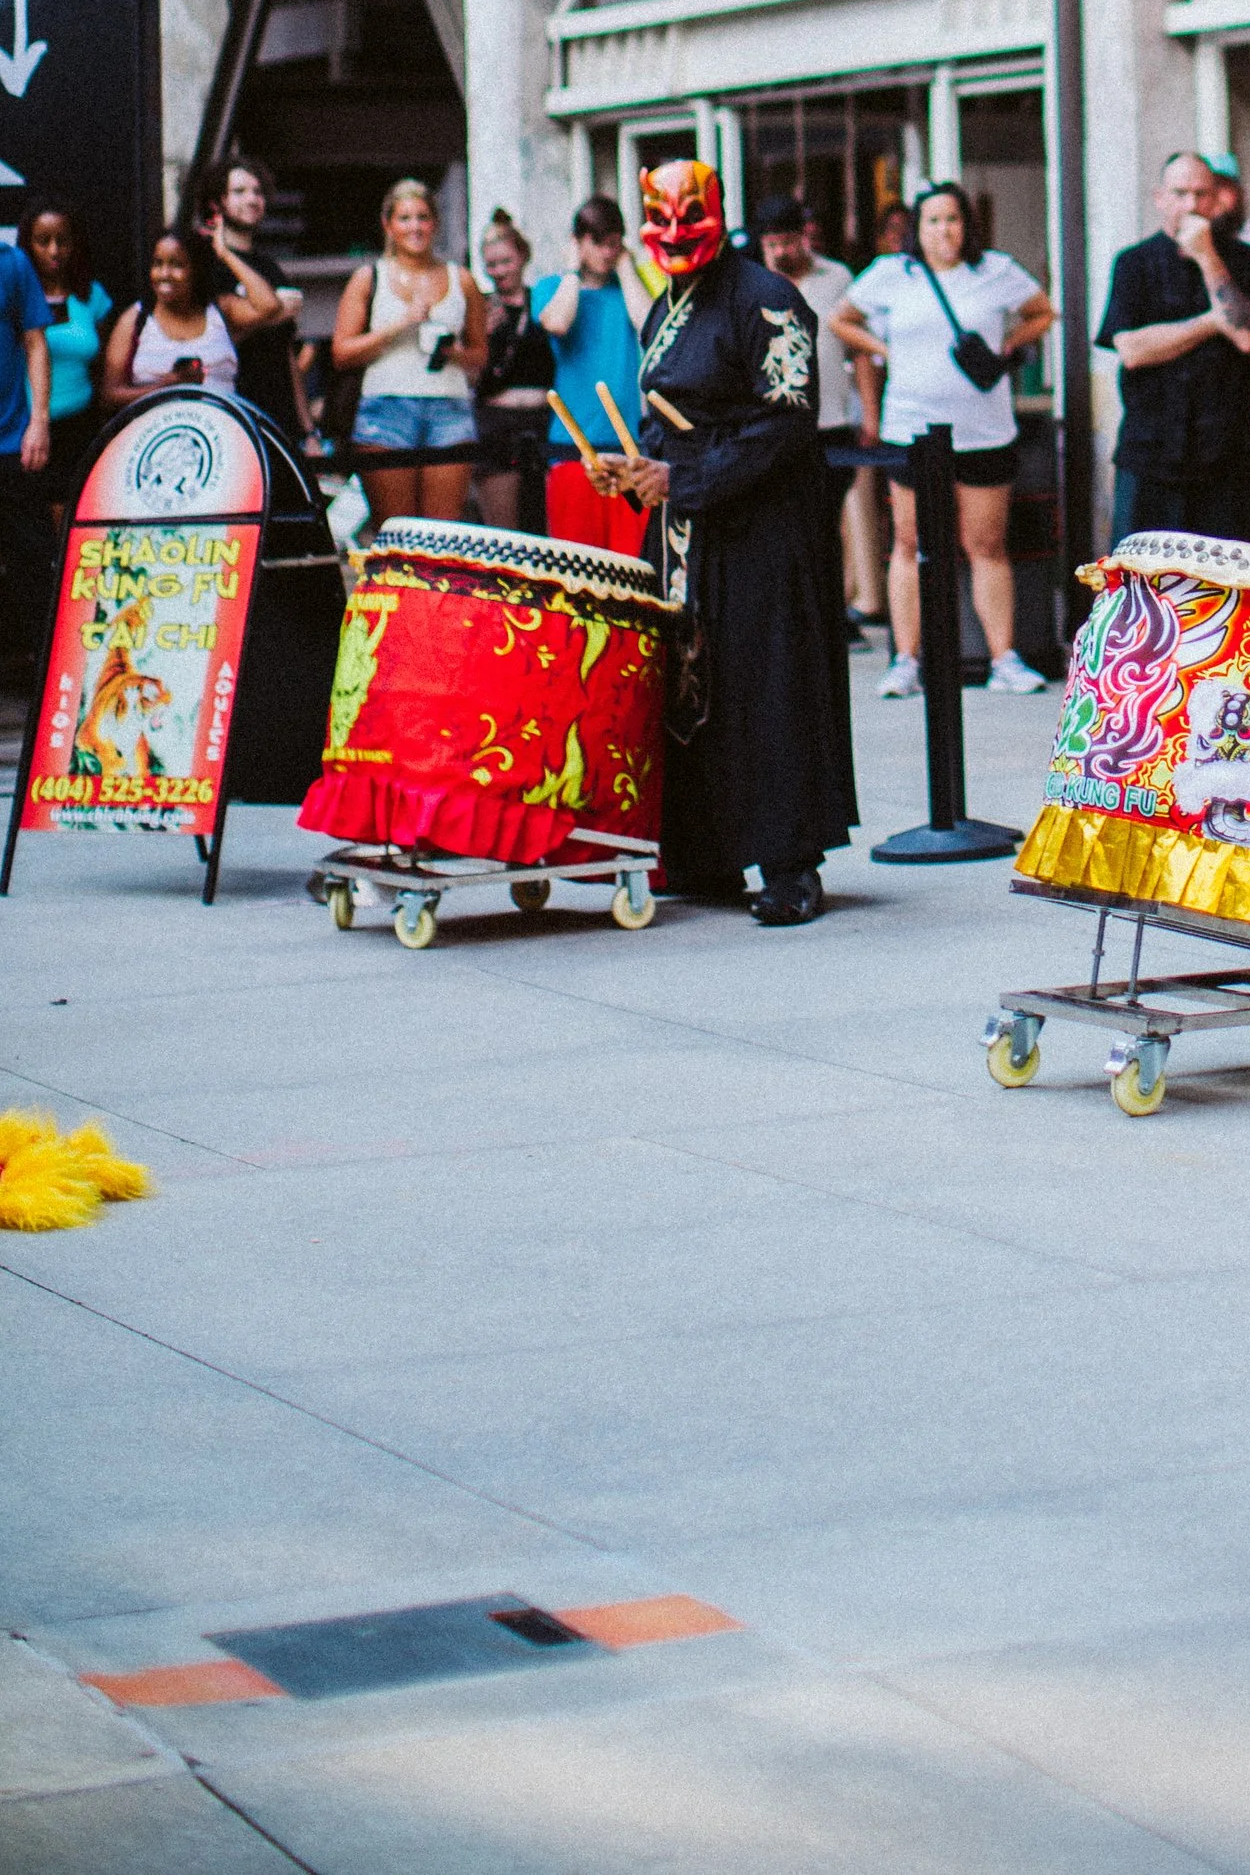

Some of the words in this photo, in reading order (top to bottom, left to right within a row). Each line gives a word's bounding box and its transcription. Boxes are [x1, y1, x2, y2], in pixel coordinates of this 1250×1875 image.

[79, 534, 241, 568] SHAOLIN
[70, 567, 184, 601] KUNG
[190, 570, 240, 605] FU
[80, 620, 147, 651] TAI
[156, 622, 218, 650] CHI
[31, 776, 93, 805] (404)
[98, 776, 214, 805] 525-3226
[1065, 774, 1121, 811] KUNG
[1123, 785, 1158, 818] FU
